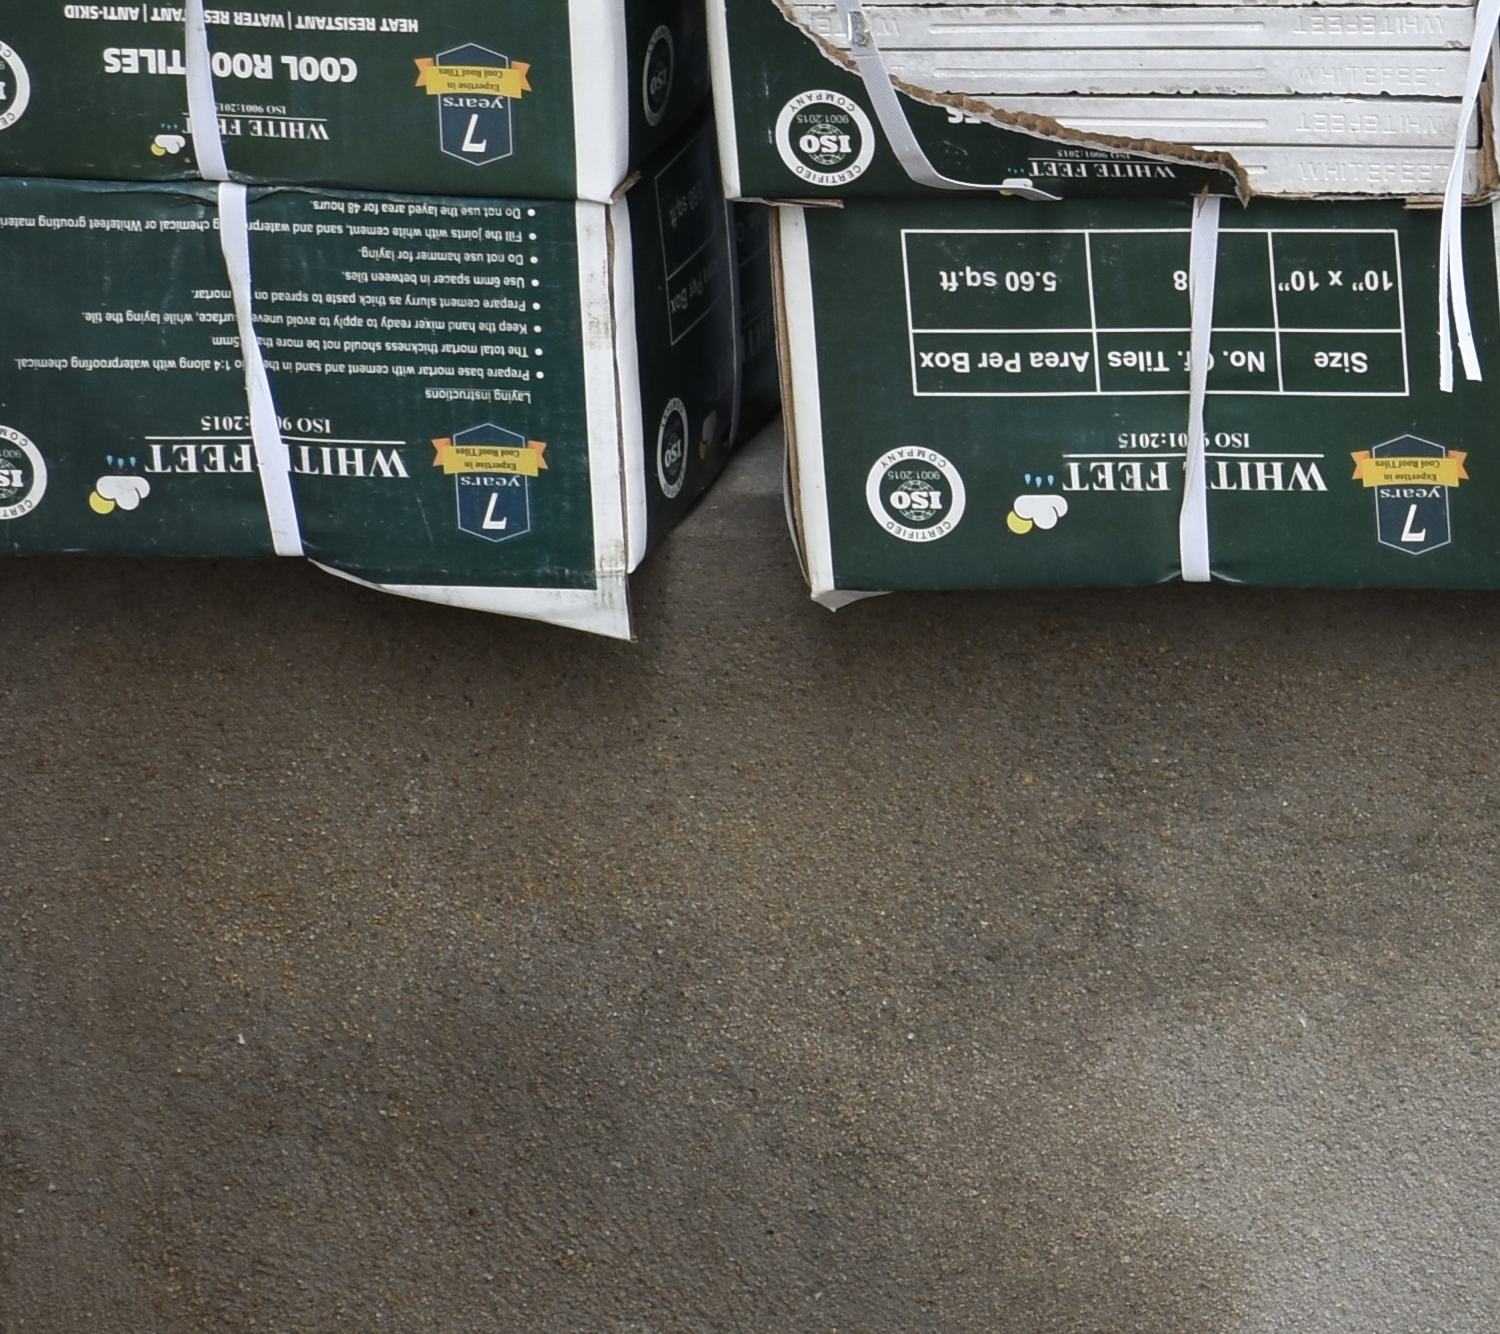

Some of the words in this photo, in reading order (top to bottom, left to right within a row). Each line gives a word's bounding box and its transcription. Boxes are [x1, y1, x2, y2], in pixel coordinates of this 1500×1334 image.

[63, 4, 141, 22] ANTI-SKID
[233, 9, 285, 28] WATER
[294, 15, 377, 32] RESISTANT
[378, 17, 419, 34] HEAT
[1290, 15, 1444, 35] WHITEFEET
[102, 47, 184, 76] TILES
[279, 54, 358, 83] COOL
[1288, 65, 1446, 86] WHITEFEET
[441, 94, 504, 112] years
[247, 119, 330, 141] WHITE
[461, 113, 488, 153] 7
[1295, 111, 1448, 134] WHITEFEET
[1027, 160, 1088, 178] FEET
[1093, 162, 1176, 178] WHITE
[1297, 162, 1449, 183] WHITEFEET
[357, 245, 396, 262] laying.
[396, 249, 415, 263] for
[414, 250, 462, 265] hammer
[463, 251, 485, 263] use
[485, 252, 506, 265] not
[506, 252, 525, 267] Do
[938, 265, 999, 293] sq.ft
[1004, 270, 1057, 293] 5.60
[1172, 269, 1188, 292] 8
[1327, 269, 1344, 287] x
[918, 351, 971, 374] Box
[976, 351, 1022, 374] Per
[1028, 350, 1090, 373] Area
[1106, 350, 1171, 373] Tiles
[1222, 349, 1266, 373] No.
[1313, 351, 1369, 374] Size
[144, 443, 252, 474] FEET
[879, 448, 947, 469] COMPANY
[459, 473, 521, 491] years
[1062, 461, 1171, 492] FEET
[888, 490, 943, 510] ISO
[1378, 484, 1441, 502] years
[481, 491, 508, 531] 7
[885, 520, 952, 540] CERTIFIED
[1400, 503, 1427, 543] 7
